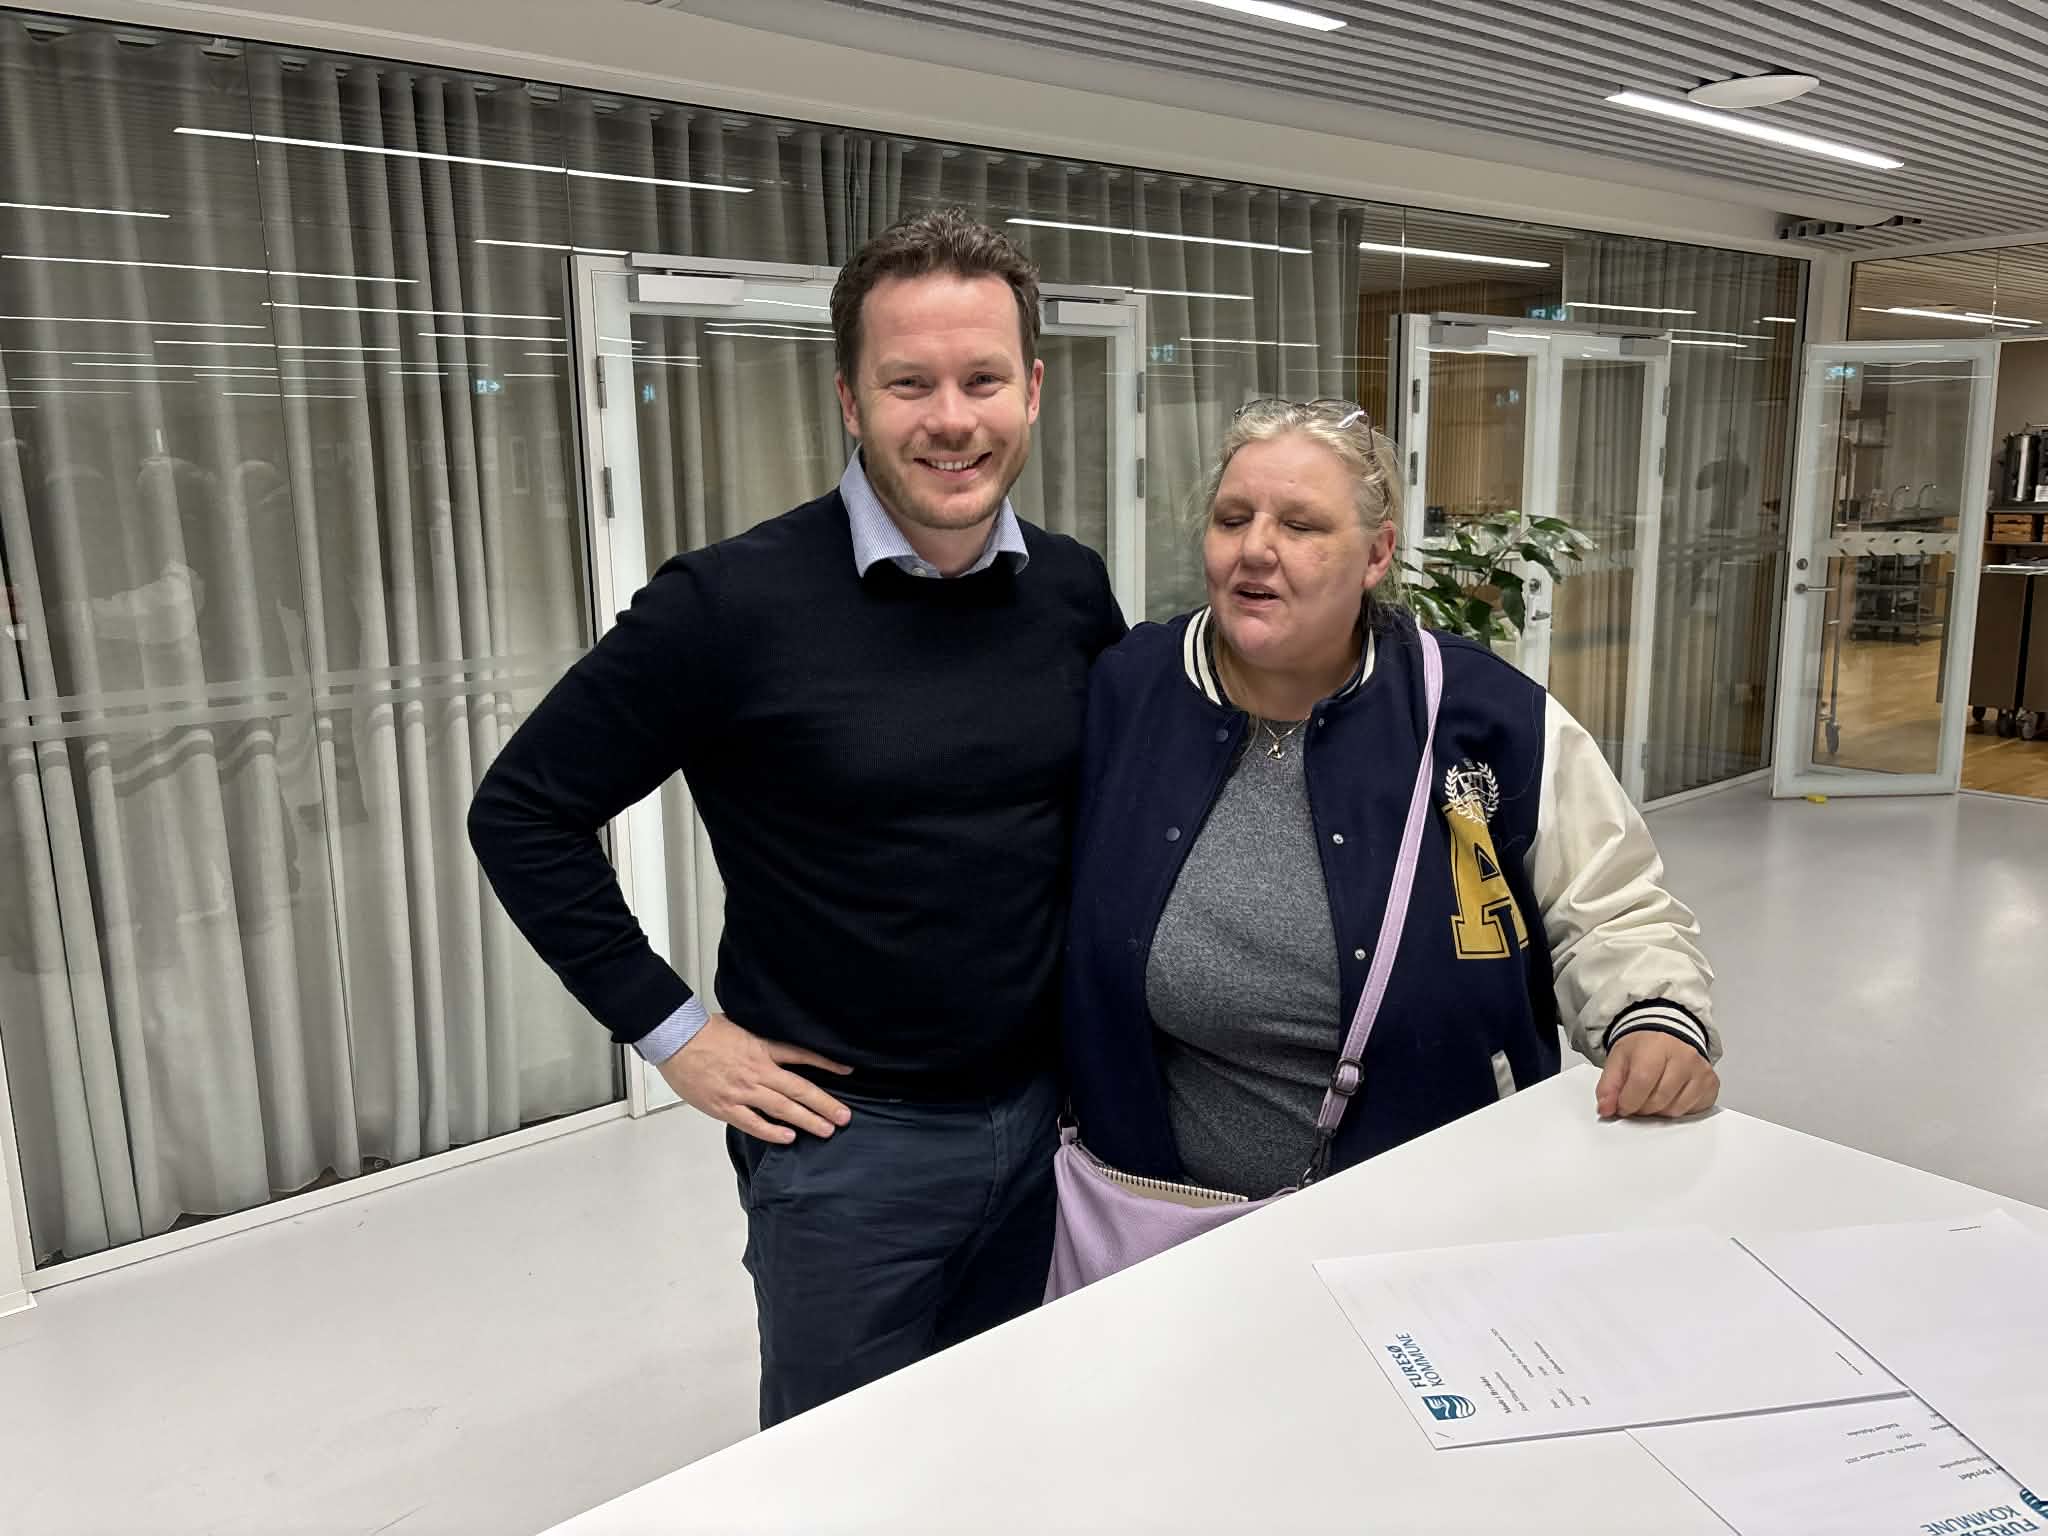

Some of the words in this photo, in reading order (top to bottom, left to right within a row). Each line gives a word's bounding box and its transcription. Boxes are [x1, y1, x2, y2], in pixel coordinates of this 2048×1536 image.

[1443, 800, 1529, 959] A
[1385, 1345, 1427, 1388] FURESØ
[1395, 1333, 1446, 1387] KOMMUNE
[1920, 1504, 2021, 1536] KOMMUNE
